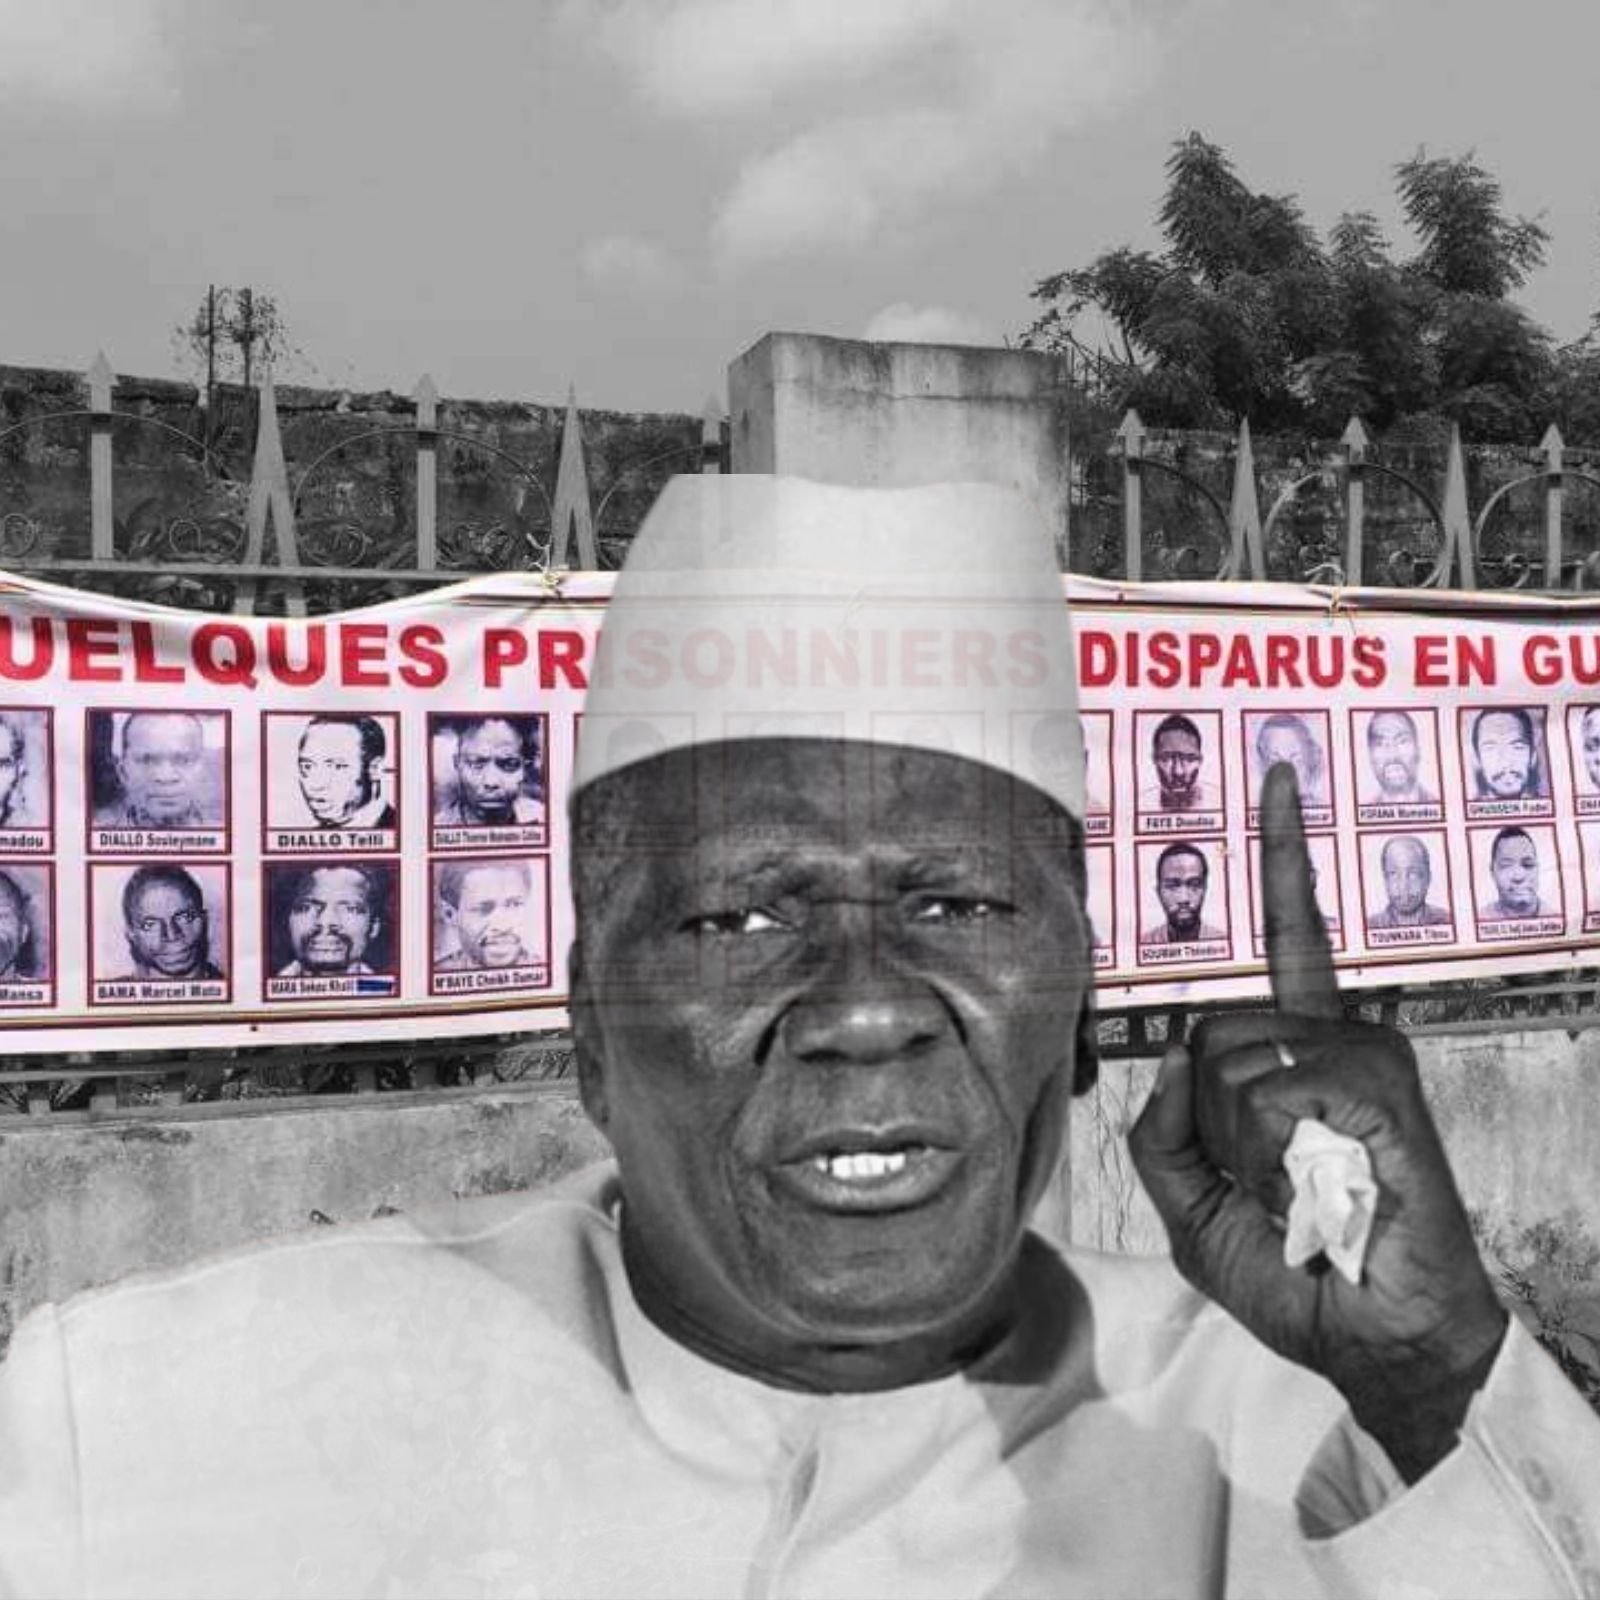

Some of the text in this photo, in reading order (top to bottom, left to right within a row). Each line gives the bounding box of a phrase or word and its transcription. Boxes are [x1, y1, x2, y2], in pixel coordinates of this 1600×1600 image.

[1079, 631, 1386, 689] DISPARUS
[1414, 635, 1496, 688] EN
[99, 832, 144, 848] DIALLO
[277, 832, 384, 848] DIALLO Telli
[141, 984, 186, 998] Marcel
